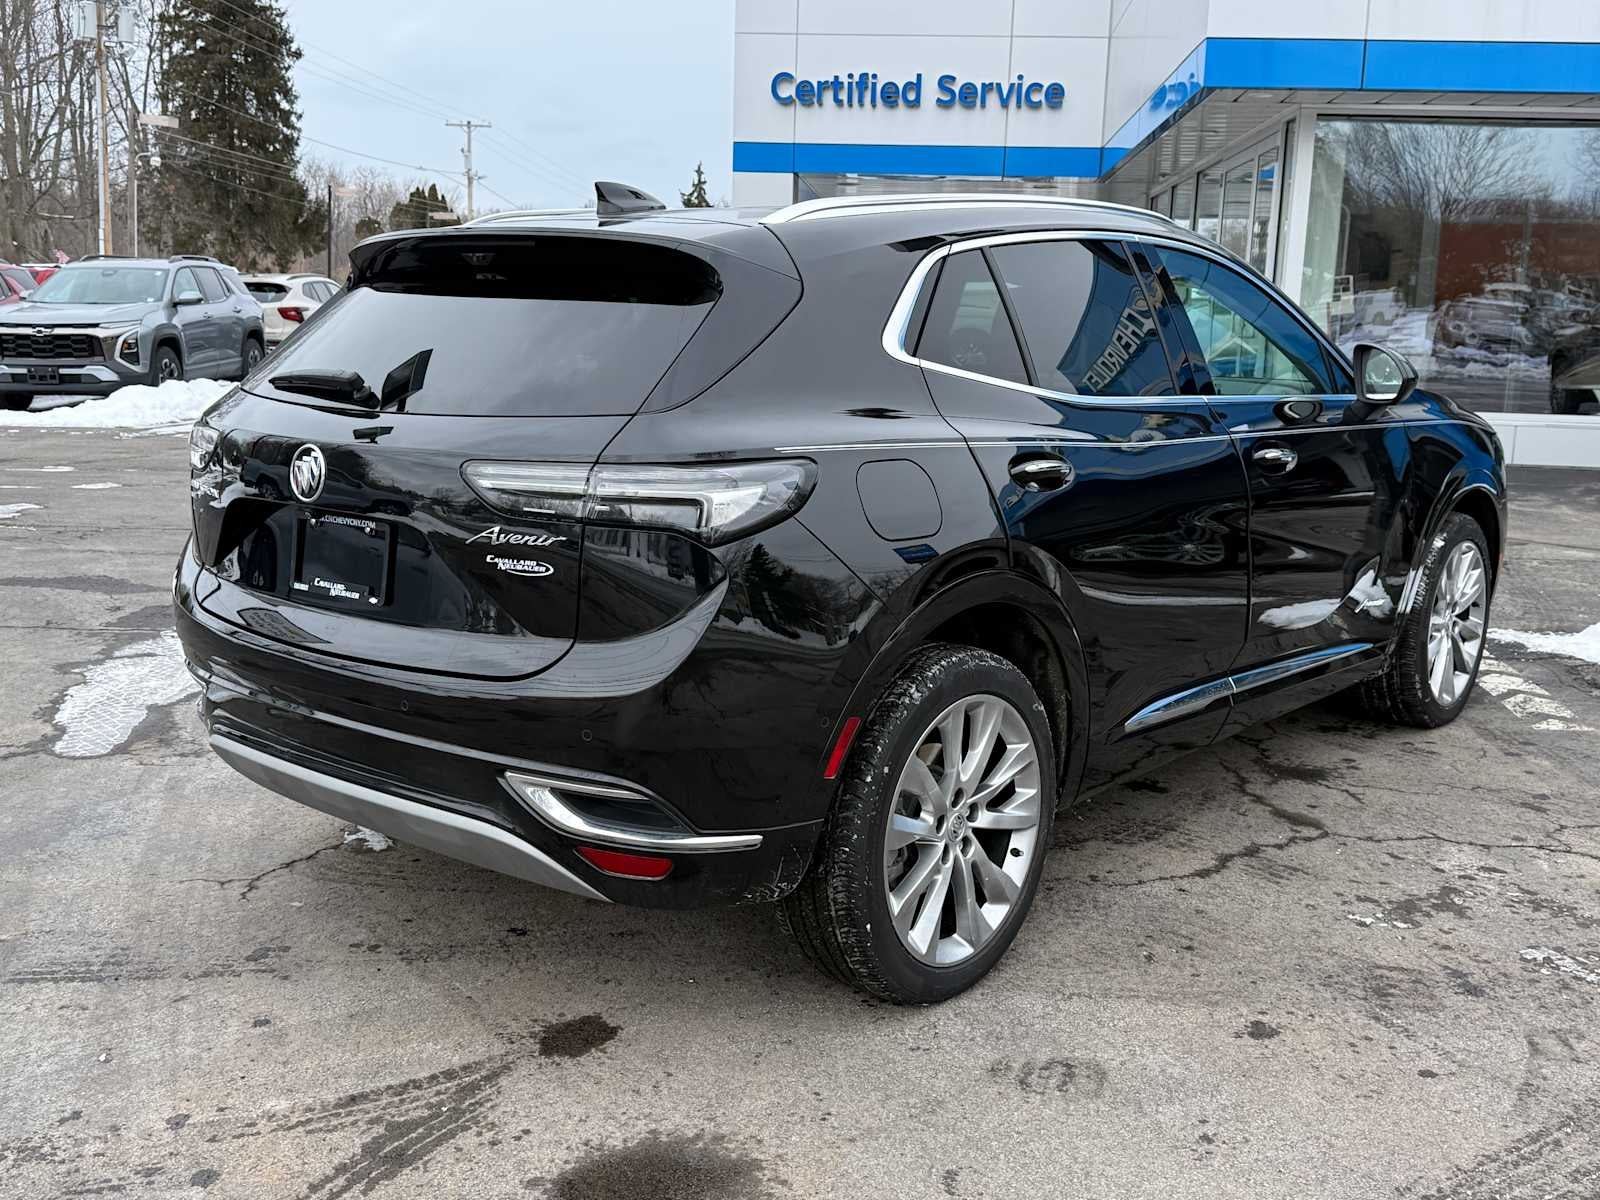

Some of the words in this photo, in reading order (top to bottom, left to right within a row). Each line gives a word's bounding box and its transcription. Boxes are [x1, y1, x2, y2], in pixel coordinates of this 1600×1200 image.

[770, 72, 922, 107] Certified
[935, 74, 1066, 109] Service
[465, 525, 567, 547] Avenir
